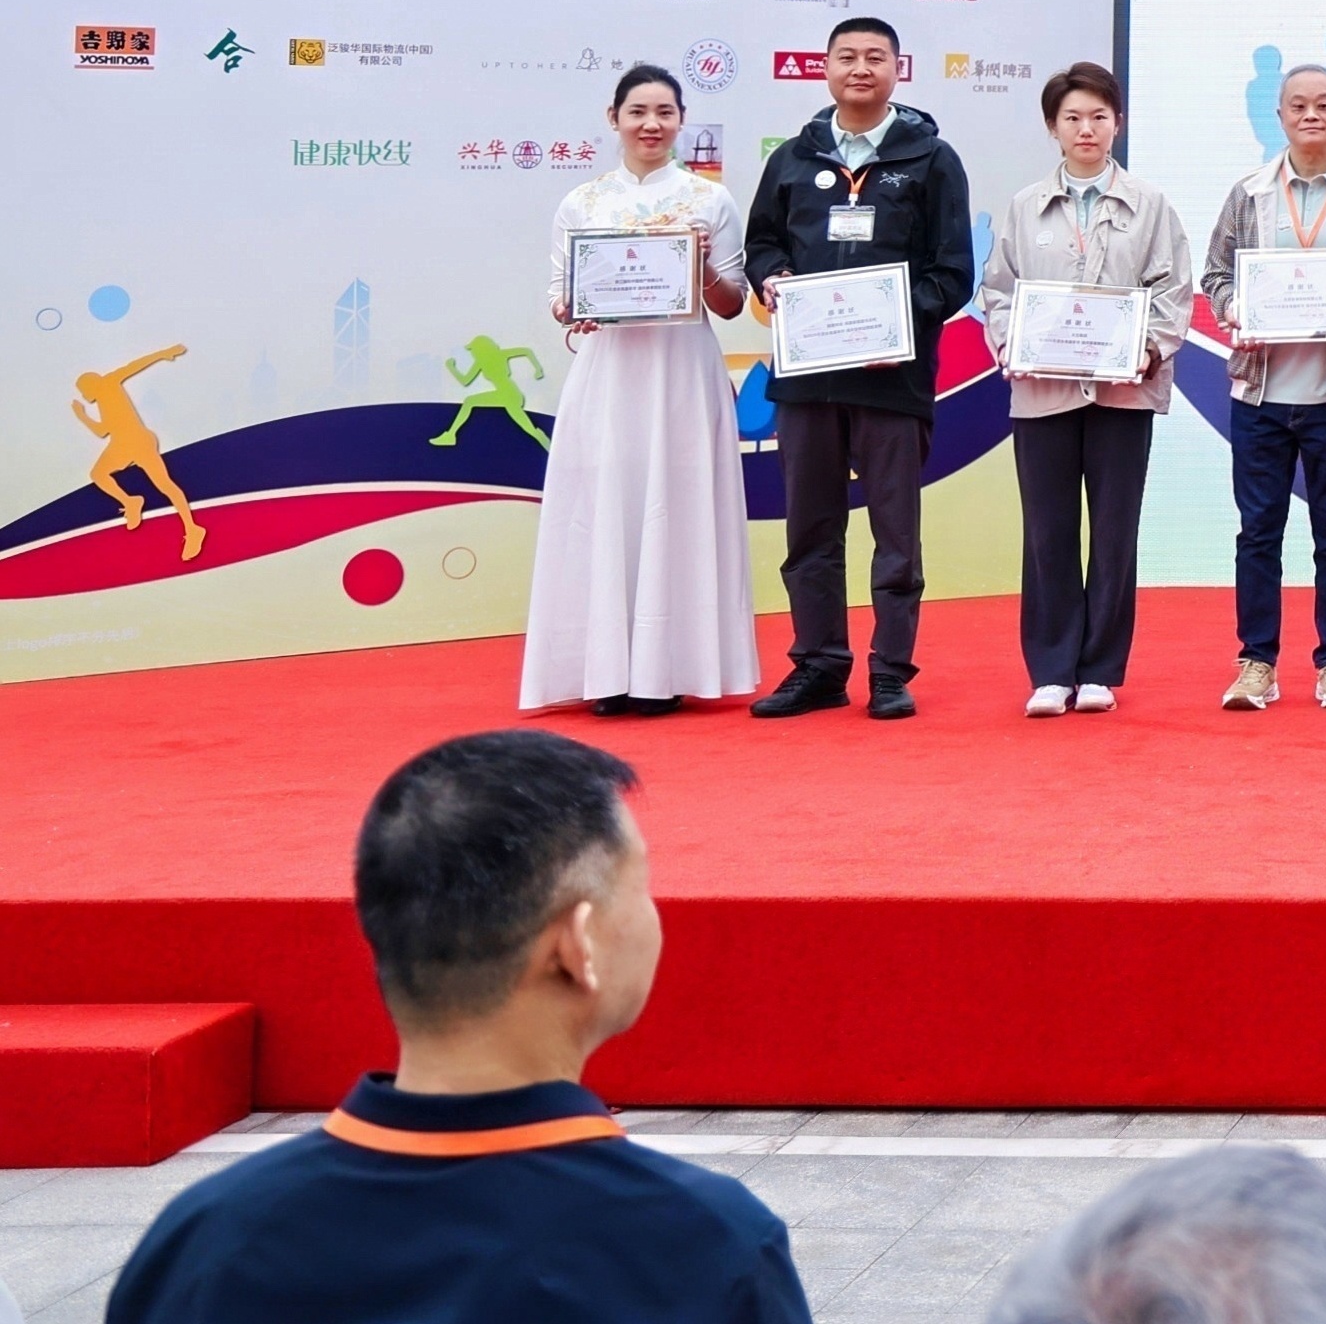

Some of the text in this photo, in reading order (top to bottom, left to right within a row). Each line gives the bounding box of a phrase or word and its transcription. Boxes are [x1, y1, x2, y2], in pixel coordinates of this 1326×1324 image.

[203, 28, 255, 74] 合
[327, 42, 434, 56] 泛骏华国际物流(中国)
[79, 54, 150, 66] YOSHINOYA
[358, 55, 403, 67] 有限公司
[973, 84, 1009, 94] CR BEER
[290, 139, 412, 167] 健康快线
[457, 139, 597, 163] 兴华 保安
